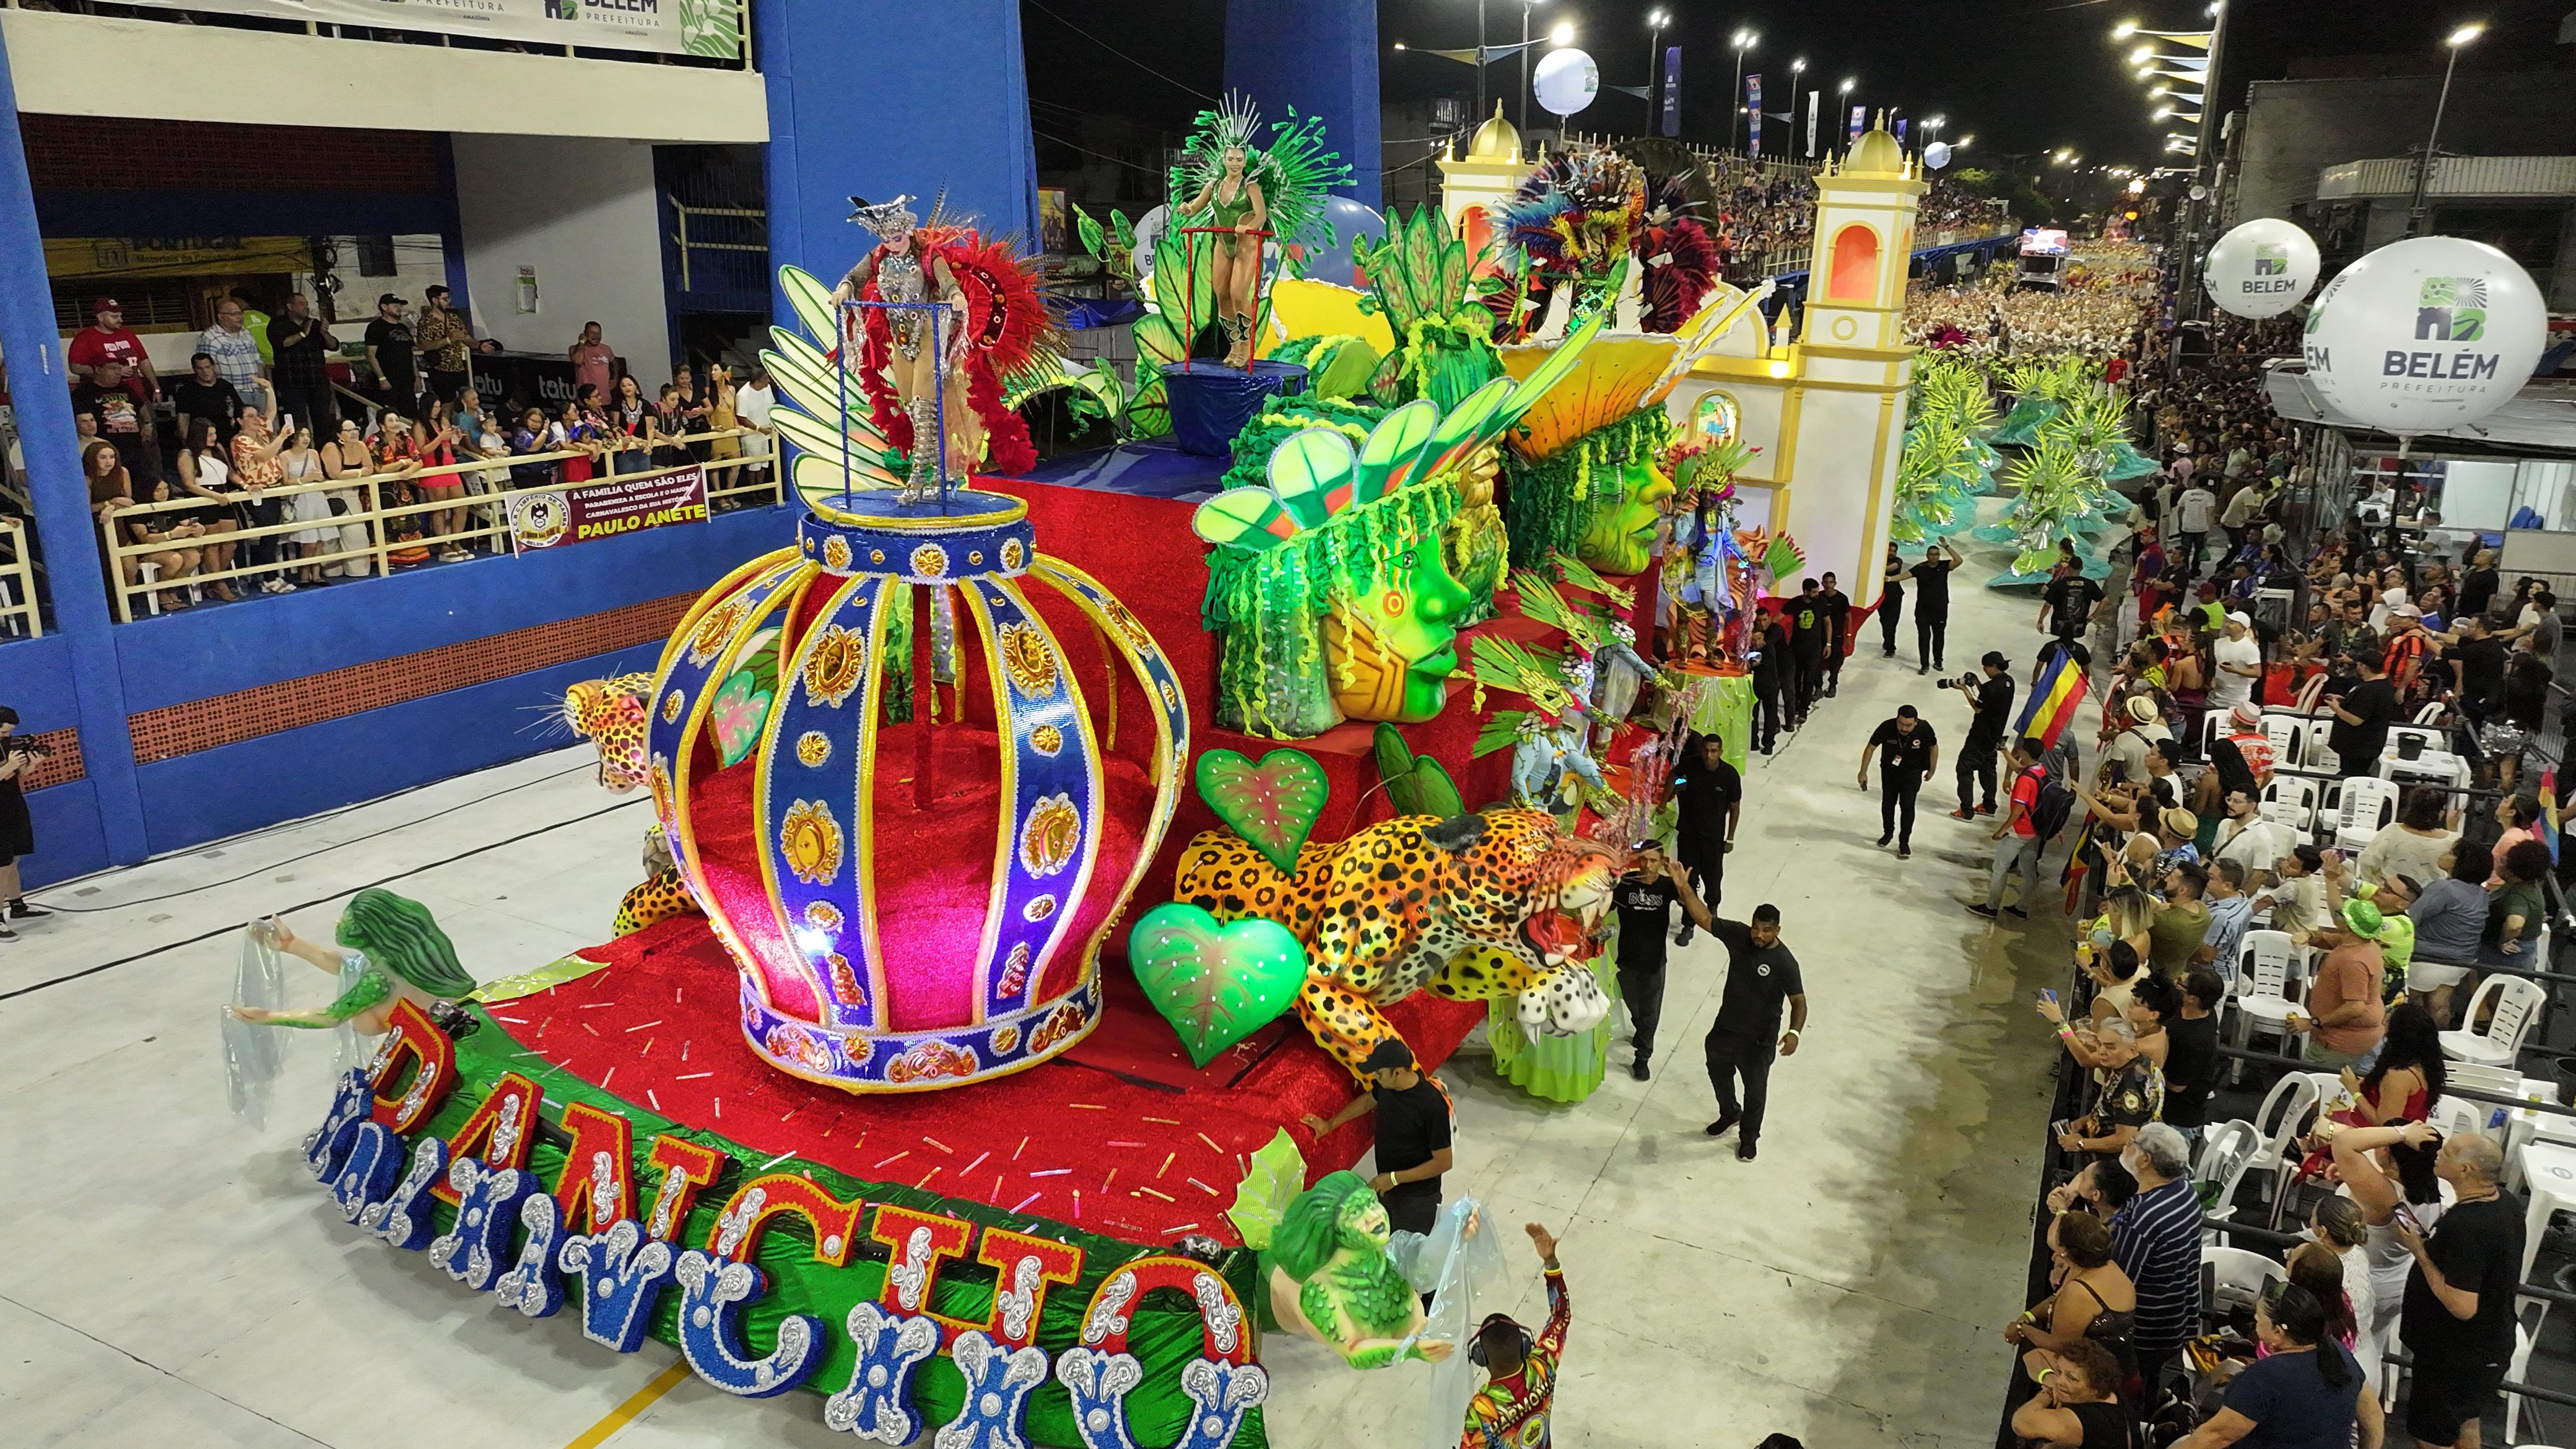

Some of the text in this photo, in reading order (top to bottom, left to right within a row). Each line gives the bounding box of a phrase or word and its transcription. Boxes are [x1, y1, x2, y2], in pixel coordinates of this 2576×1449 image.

[586, 12, 660, 27] PREFEITURA
[2242, 278, 2296, 294] BELÉM
[2383, 348, 2500, 380] BELÉM
[474, 372, 503, 396] atu
[538, 375, 577, 401] tatu
[2380, 381, 2486, 394] PREFEITURA
[573, 472, 697, 500] A FAMILIA QUEM SÃO ELES
[635, 492, 659, 500] ESCOLA
[558, 503, 567, 526] SAMBA
[585, 505, 638, 519] CARNAVALESCO
[662, 495, 693, 505] HISTÓRIA
[578, 515, 640, 539] PAULO
[644, 504, 707, 527] ANETE
[1628, 892, 1663, 906] BOSS
